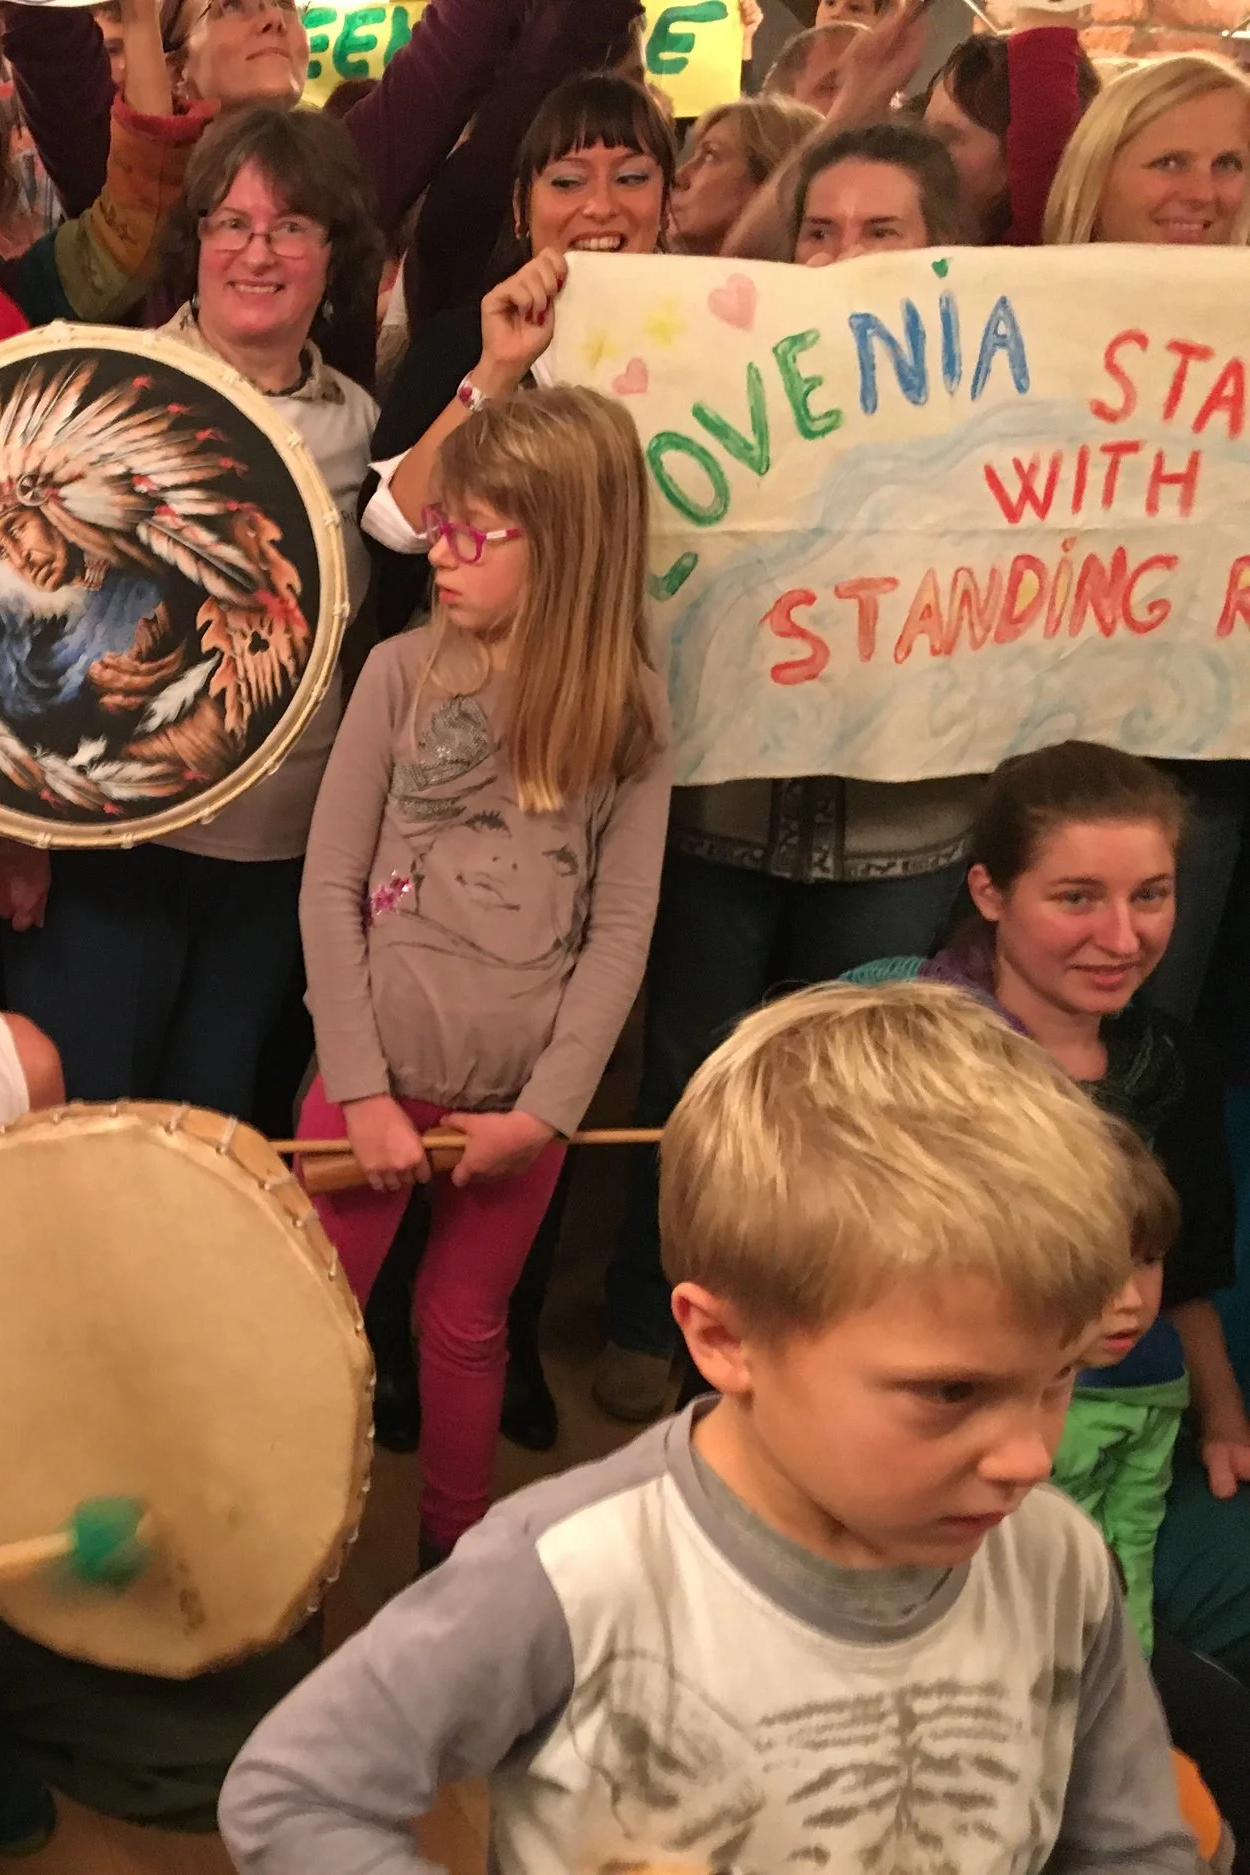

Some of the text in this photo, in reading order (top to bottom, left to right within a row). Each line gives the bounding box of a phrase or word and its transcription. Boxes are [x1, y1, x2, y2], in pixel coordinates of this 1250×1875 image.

[1089, 328, 1246, 440] STA
[984, 439, 1202, 524] WITH
[761, 537, 1179, 686] STANDING
